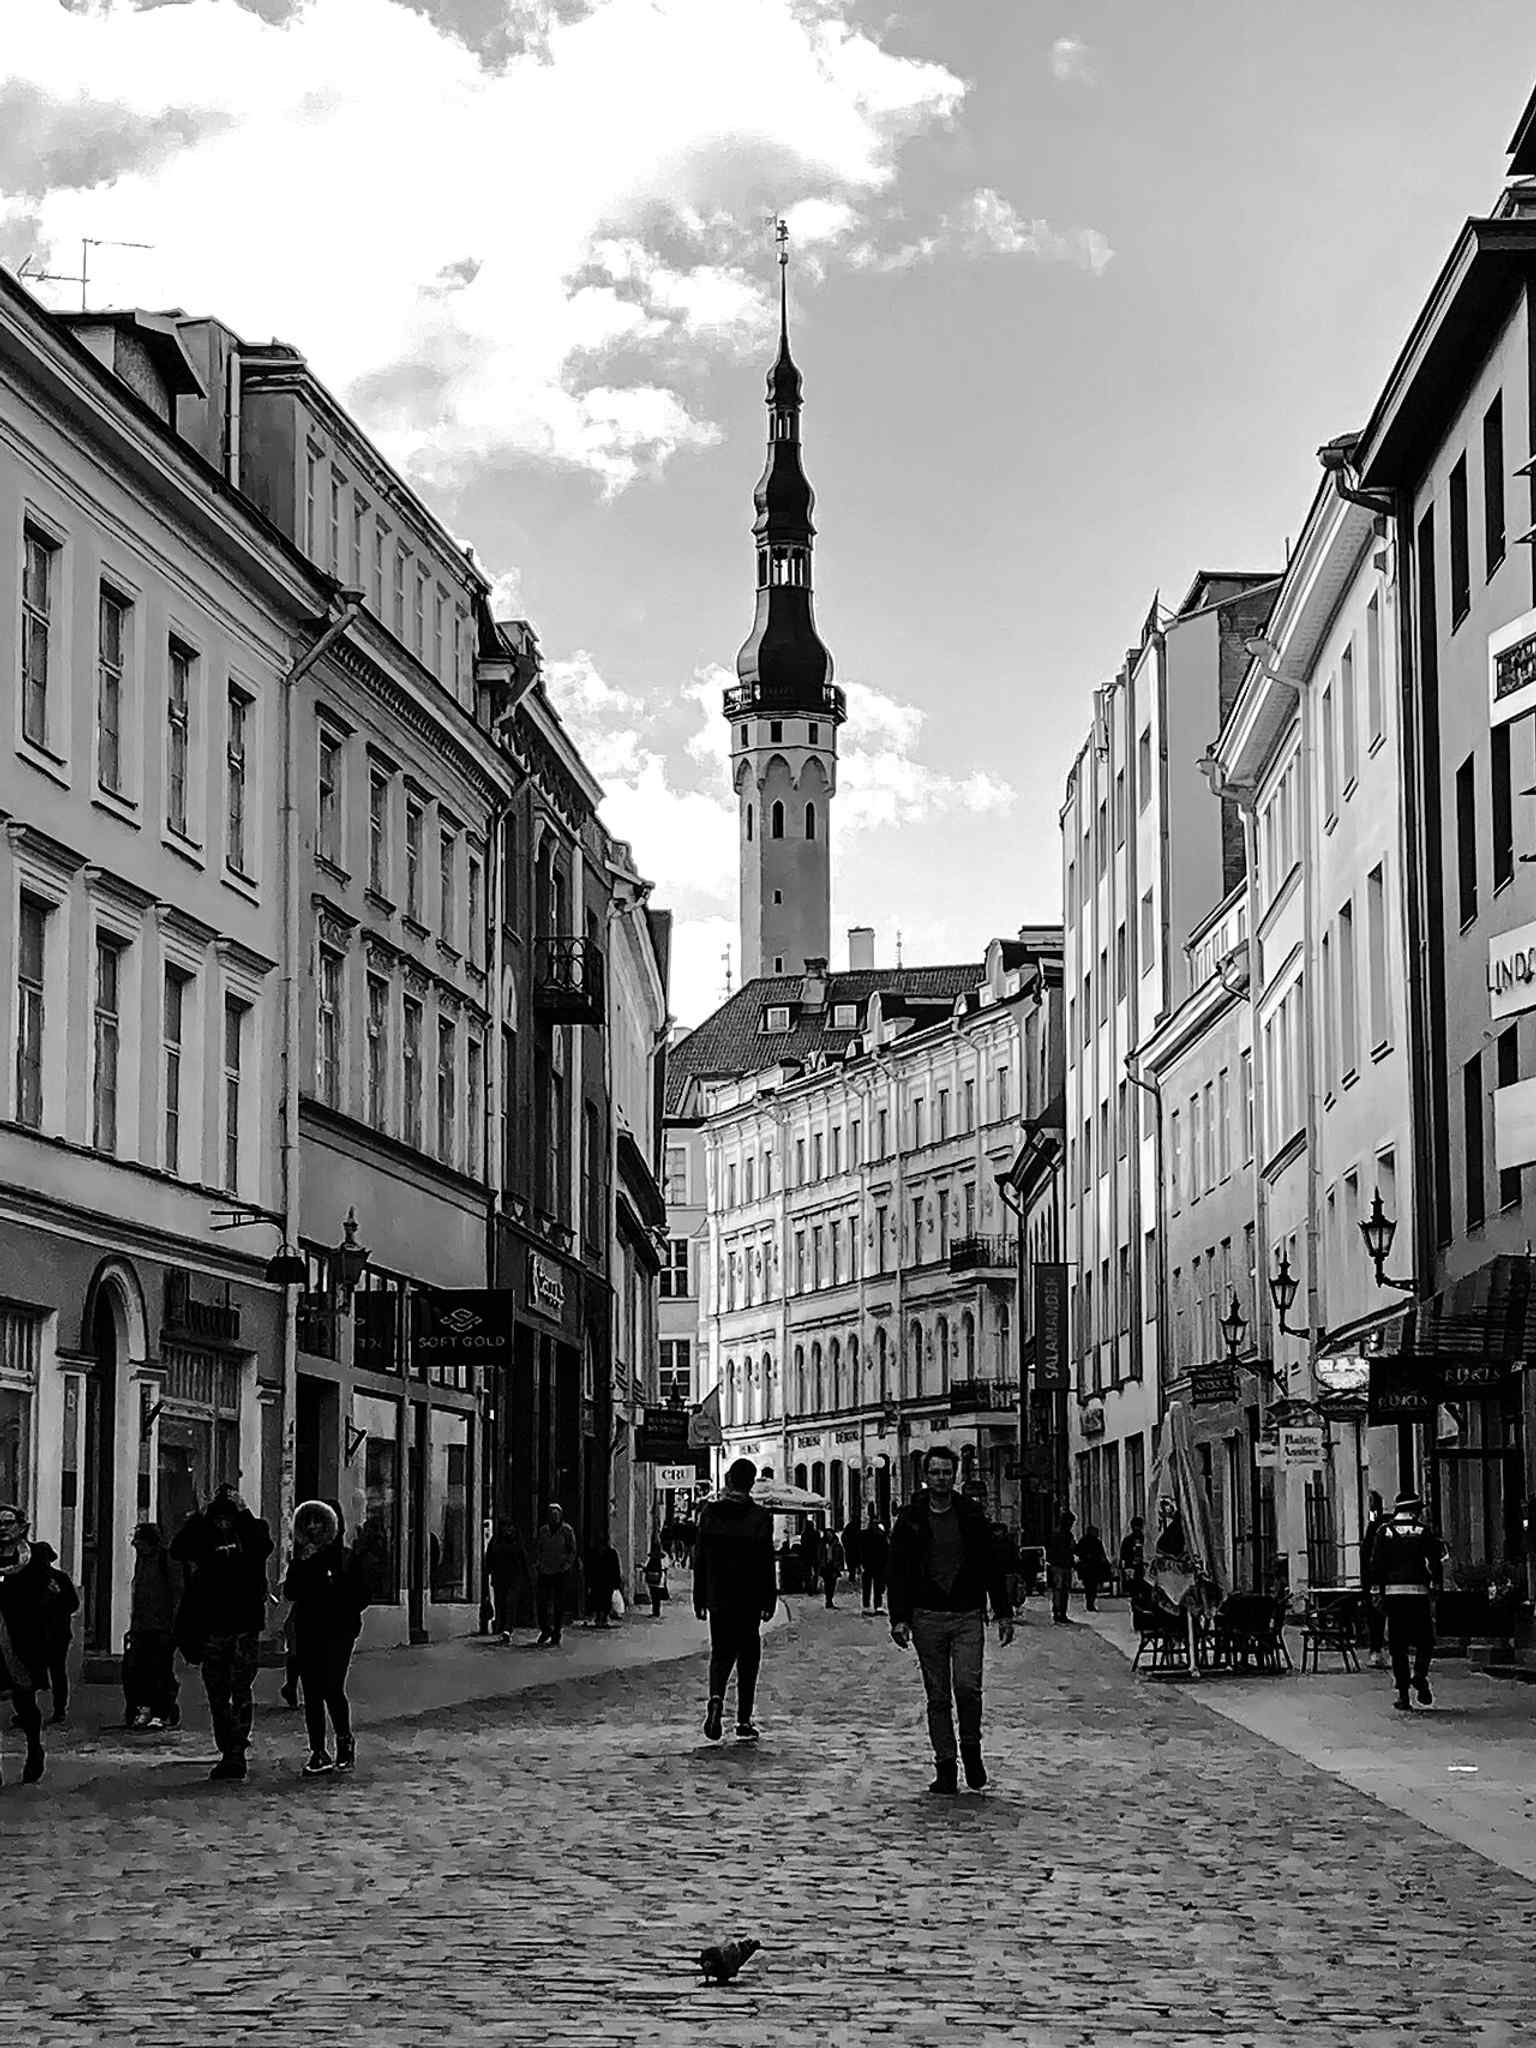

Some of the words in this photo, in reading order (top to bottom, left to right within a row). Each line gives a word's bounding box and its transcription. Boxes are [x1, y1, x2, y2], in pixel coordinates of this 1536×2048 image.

[417, 1335, 458, 1349] SOFT
[462, 1335, 506, 1348] GOLD
[1044, 1275, 1060, 1380] SALAMANDER
